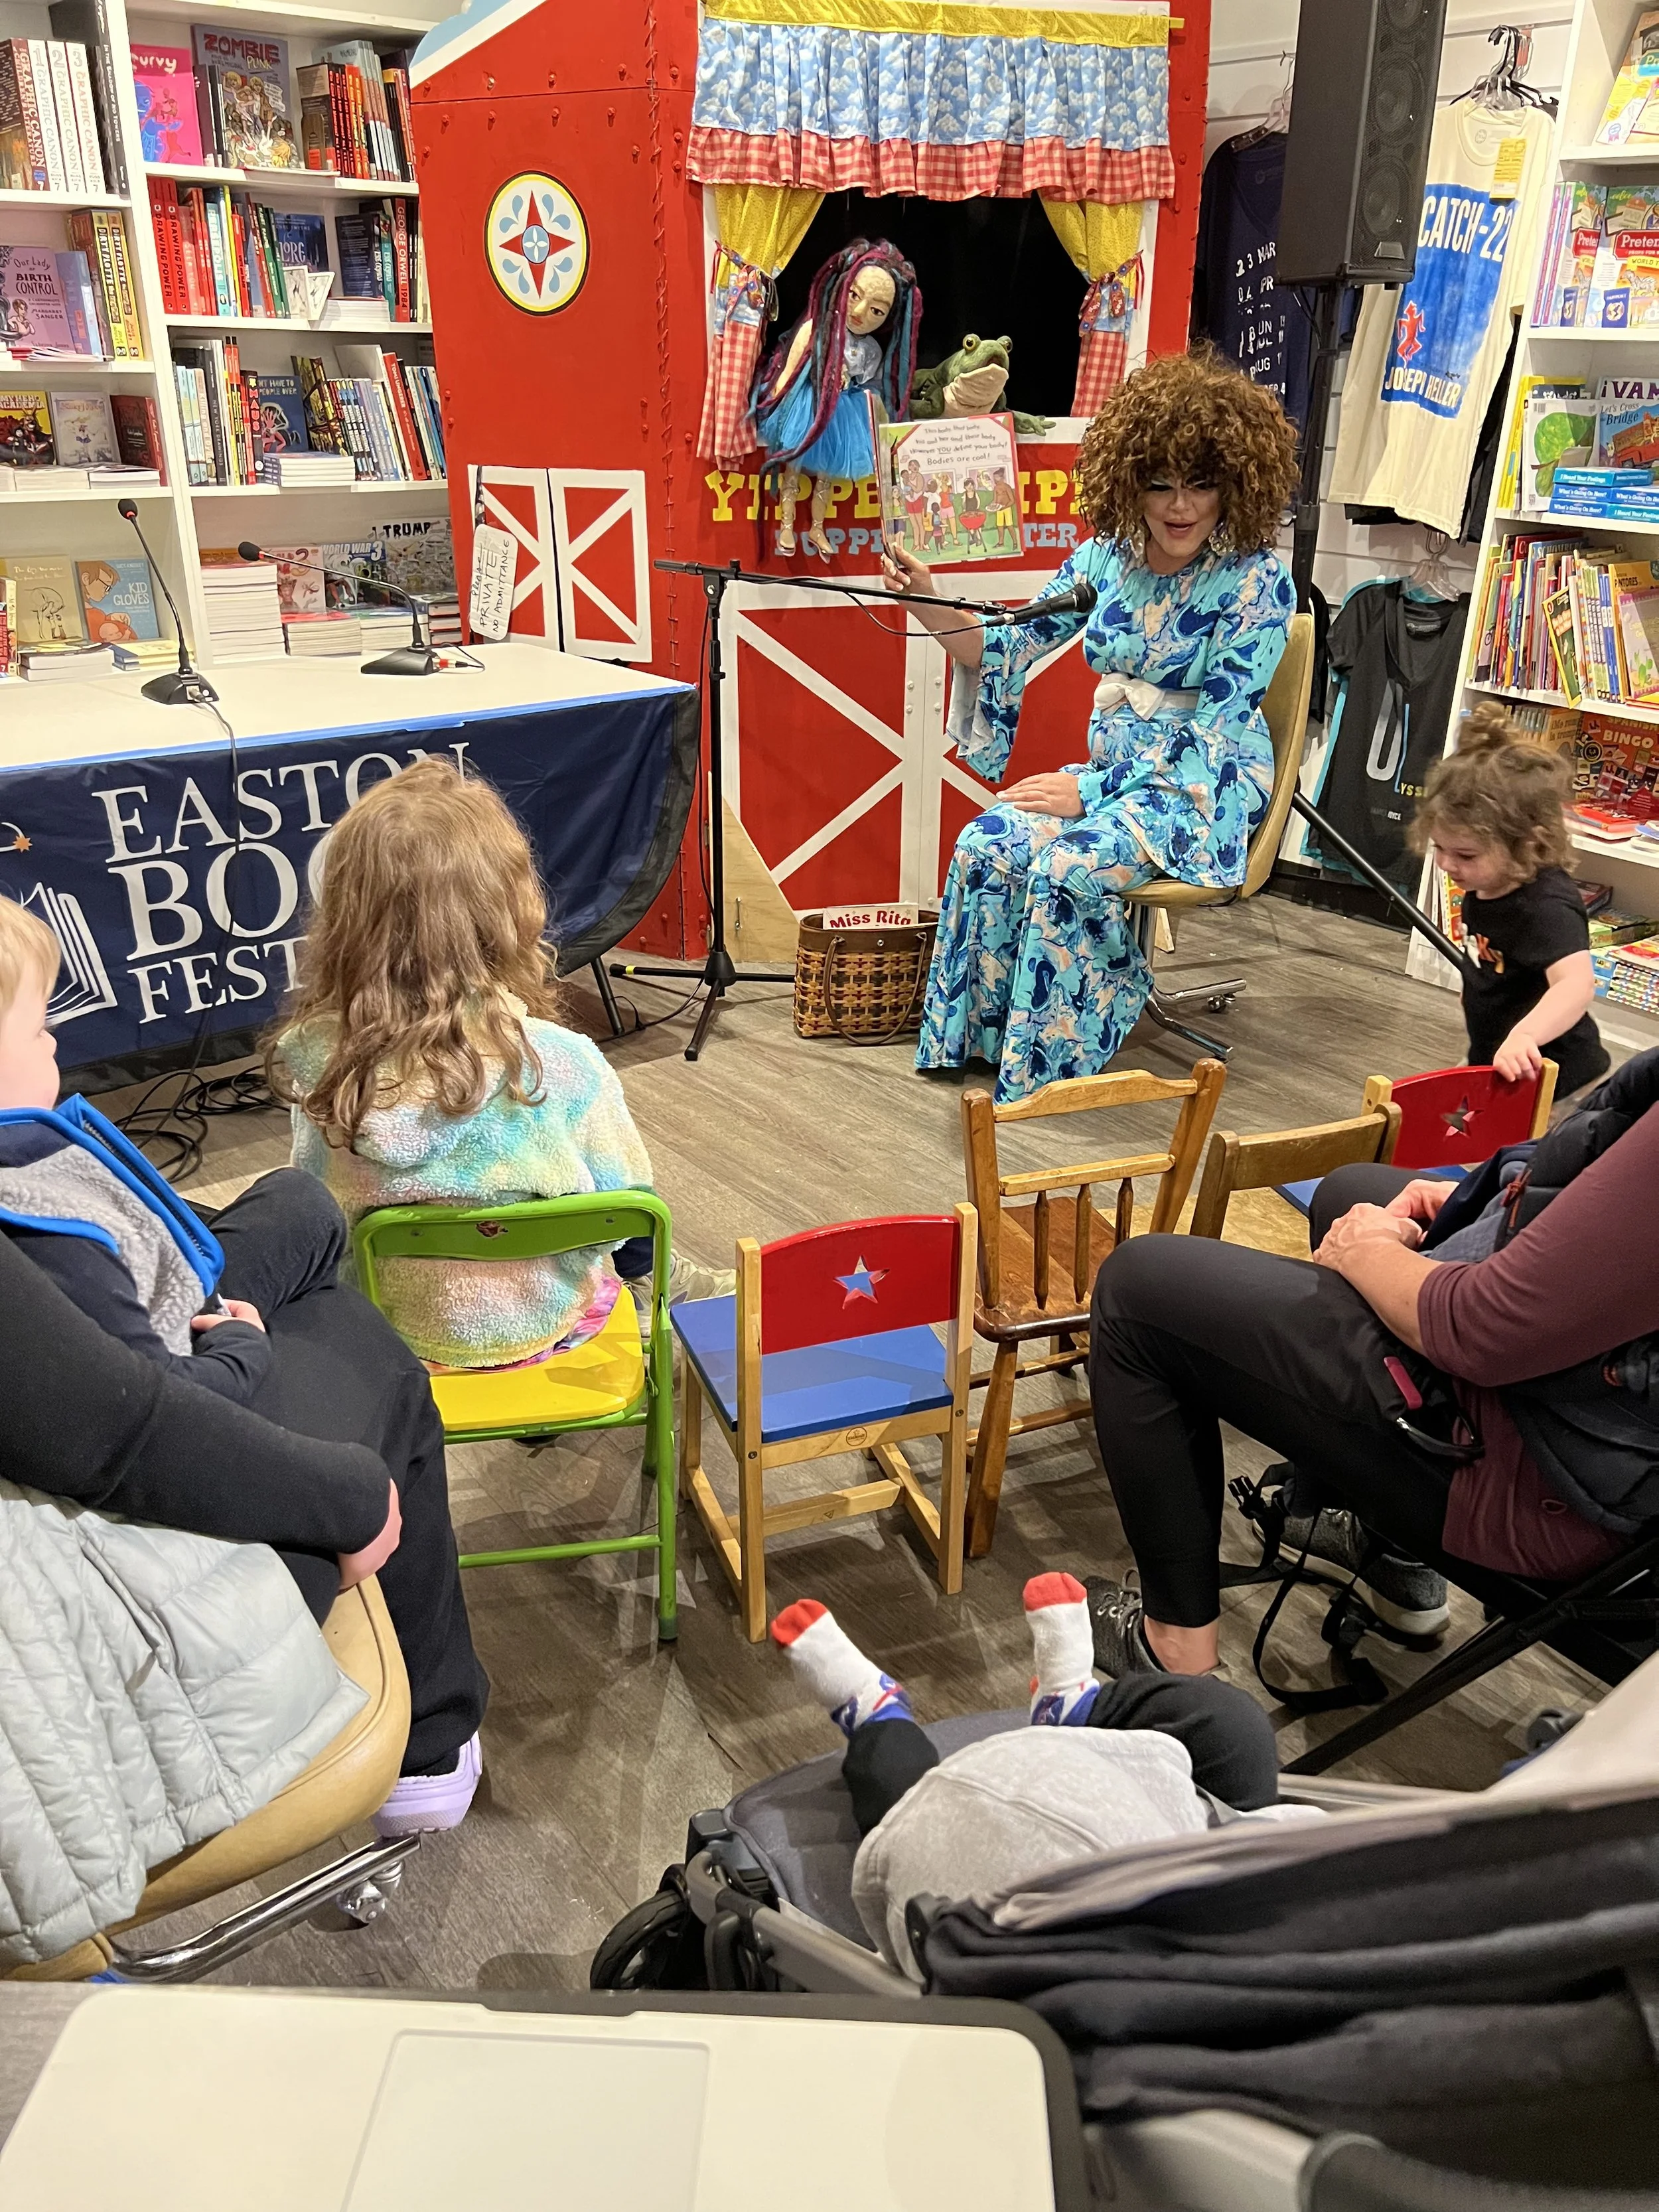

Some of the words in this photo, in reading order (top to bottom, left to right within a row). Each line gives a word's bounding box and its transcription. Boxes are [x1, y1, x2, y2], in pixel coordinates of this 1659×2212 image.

[52, 49, 65, 68] 2
[73, 50, 83, 67] 3
[204, 34, 280, 63] ZOMBIE
[247, 56, 273, 70] PUNK
[37, 68, 52, 125] GRAPHIC
[46, 128, 59, 170] CANON
[56, 71, 72, 126] GRAPHIC
[66, 129, 78, 171] CANON
[76, 72, 90, 127] GRAPHIC
[85, 129, 98, 171] CANON
[112, 115, 121, 142] TOWERS
[31, 121, 45, 167] CANON
[397, 206, 406, 247] GEORGE
[1417, 196, 1513, 263] CATCH-22
[1577, 232, 1598, 246] Prete
[1621, 235, 1659, 248] Preten
[14, 258, 29, 267] Our
[32, 257, 50, 270] Lady
[155, 213, 168, 261] DRAWING
[163, 263, 172, 297] POWER
[169, 215, 180, 261] DRAWING
[175, 264, 186, 298] POWER
[1258, 242, 1275, 264] MAR
[17, 273, 52, 282] BIRTH
[399, 250, 407, 285] ORWELL
[16, 282, 58, 295] CONTROL
[395, 380, 405, 408] UNGERER
[1424, 375, 1462, 408] HELLER
[1601, 380, 1659, 400] ¡VAM
[199, 393, 208, 419] Killing
[250, 388, 260, 431] MAUS
[1601, 404, 1617, 414] Let's
[1620, 403, 1640, 411] Cross
[1607, 411, 1638, 425] Bridge
[382, 522, 431, 540] TRUMP
[1023, 522, 1078, 548] TER
[323, 544, 350, 555] WORLD
[351, 542, 372, 553] WAR
[371, 541, 383, 561] 3
[494, 540, 509, 613] ADMITTANCE
[1615, 577, 1638, 587] PNTORES
[113, 593, 149, 605] GLOVES
[129, 582, 147, 594] KID
[480, 549, 497, 627] PRIVATE
[492, 619, 499, 632] NO
[1603, 730, 1654, 749] BINGO
[830, 913, 871, 928] Miss
[876, 910, 911, 925] Rita
[127, 936, 309, 1025] FEST
